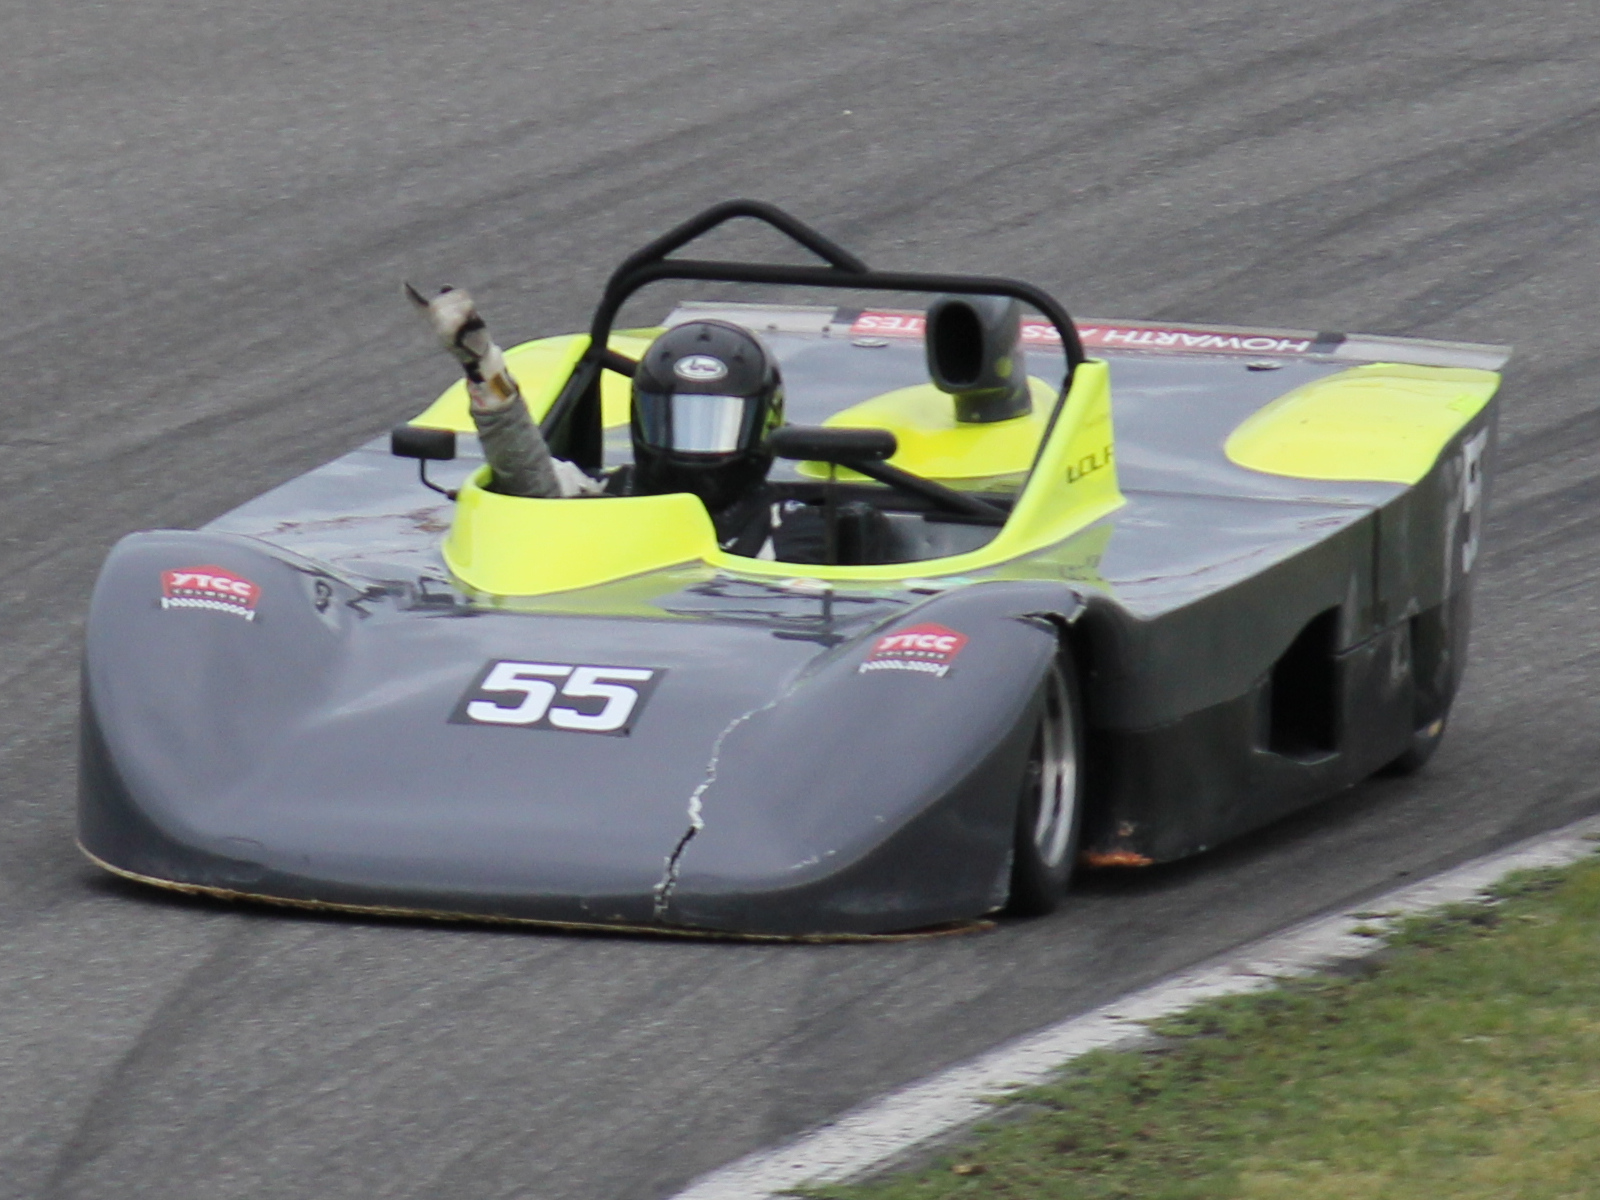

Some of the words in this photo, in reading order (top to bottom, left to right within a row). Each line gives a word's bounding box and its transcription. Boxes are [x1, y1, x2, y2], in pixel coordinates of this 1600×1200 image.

[1103, 329, 1311, 352] HOWARTH
[170, 572, 251, 596] YTCC
[878, 633, 957, 650] YTCC
[466, 660, 654, 731] 55
